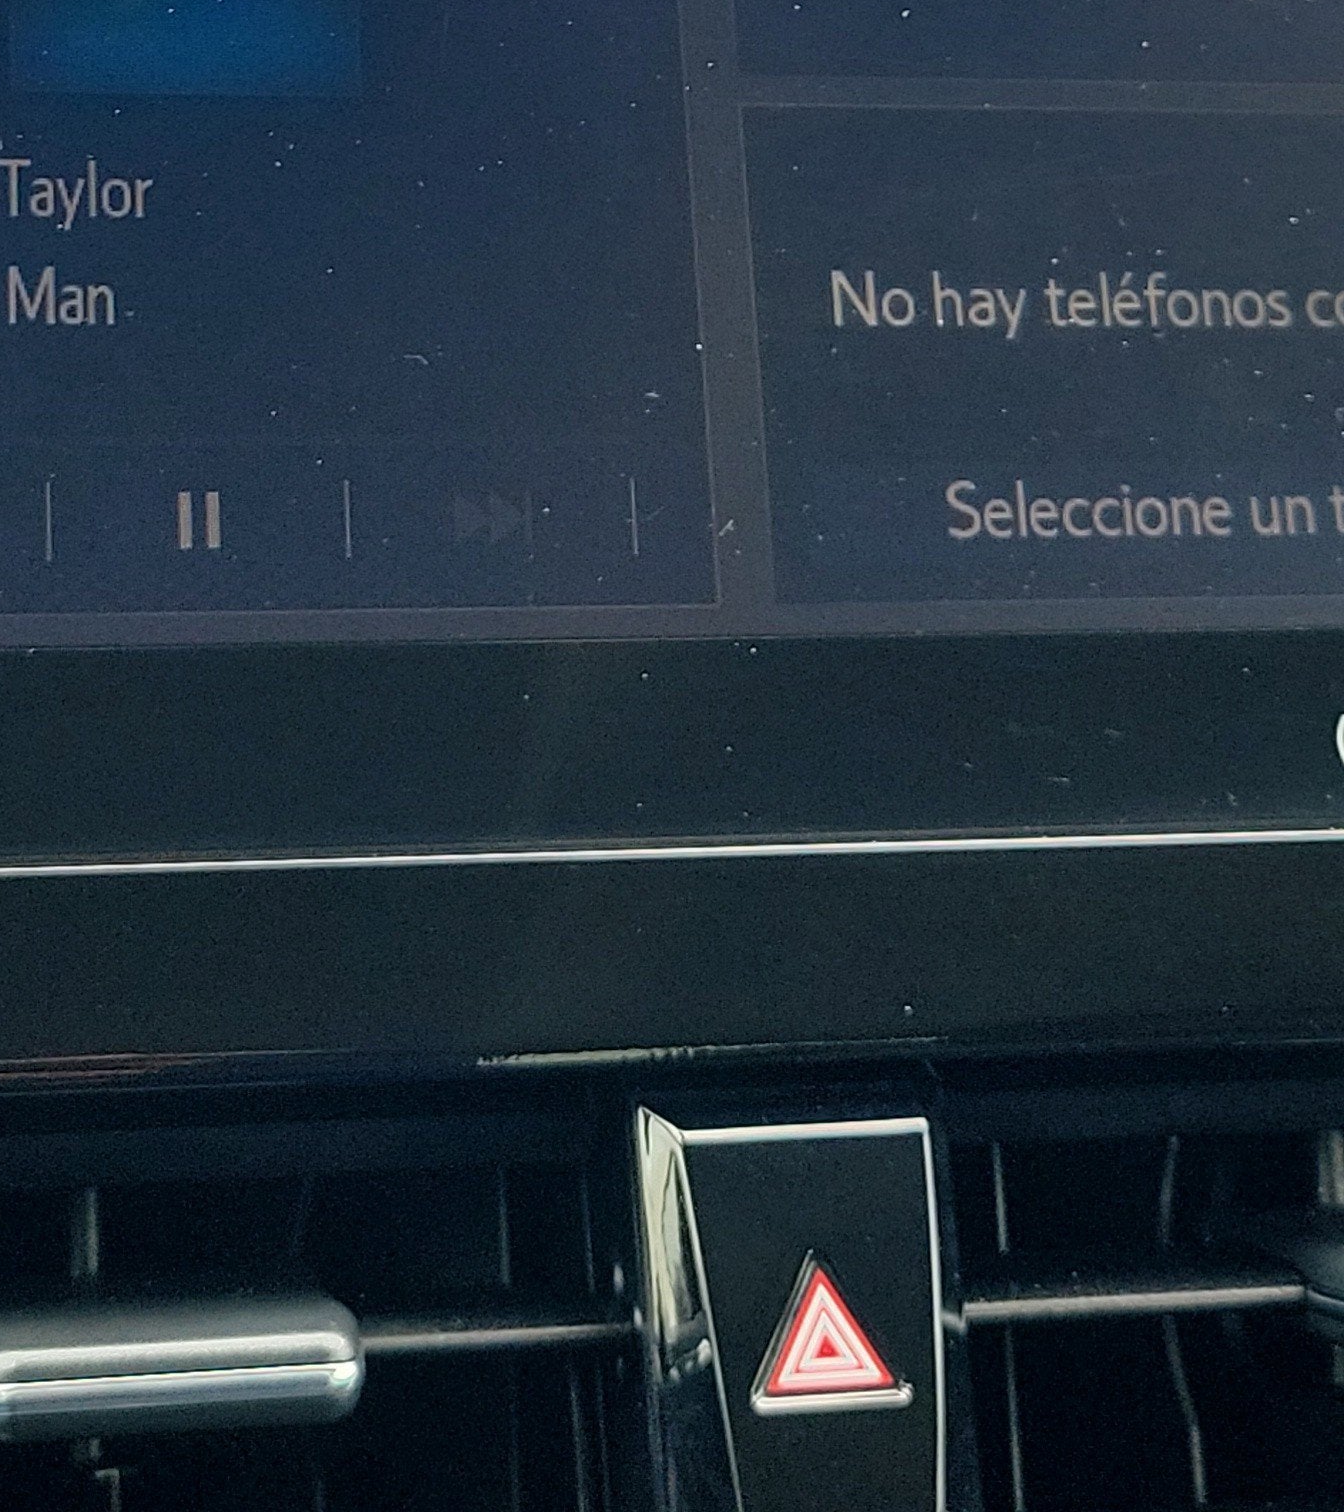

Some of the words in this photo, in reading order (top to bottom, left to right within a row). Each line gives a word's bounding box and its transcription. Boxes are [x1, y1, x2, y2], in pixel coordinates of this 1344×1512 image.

[7, 264, 116, 325] Man
[831, 269, 915, 328] No
[932, 269, 1027, 341] hay
[1044, 270, 1293, 330] teléfonos
[946, 479, 1234, 540] Seleccione
[1250, 492, 1317, 537] un
